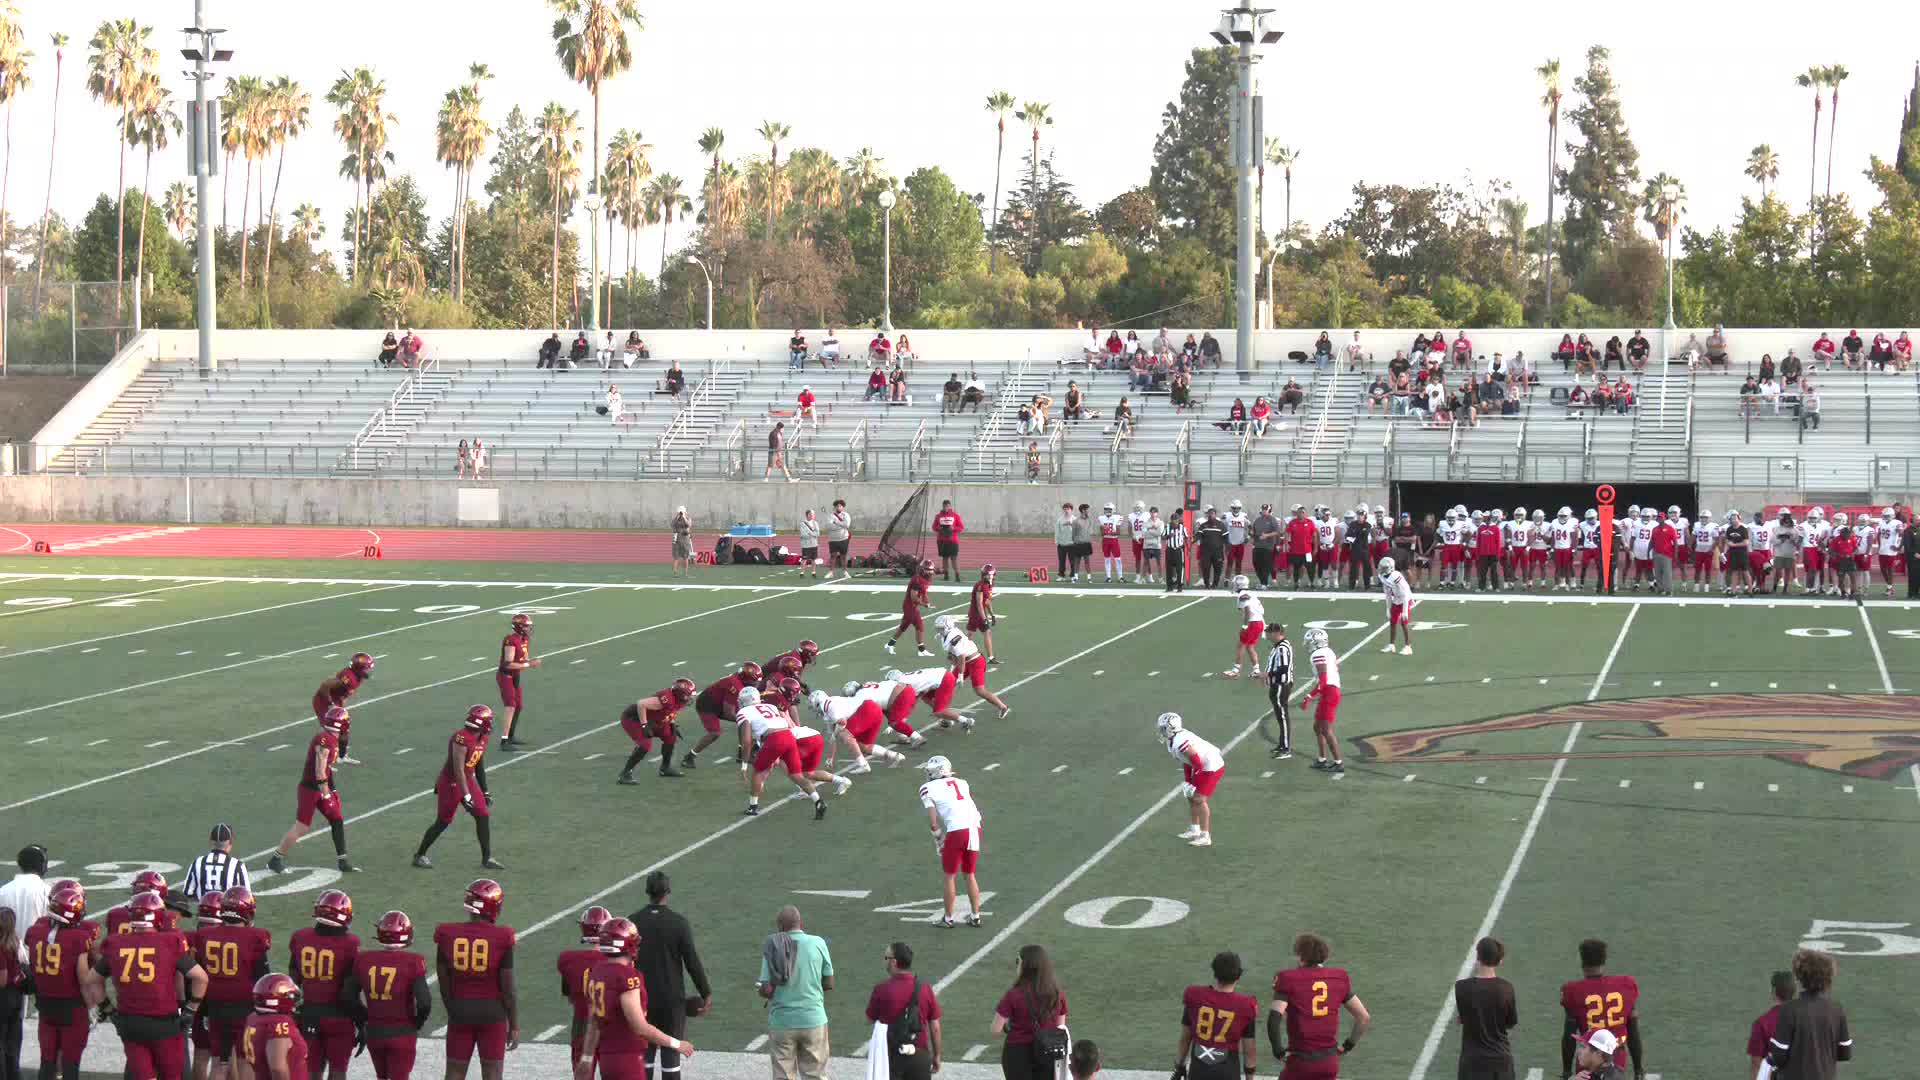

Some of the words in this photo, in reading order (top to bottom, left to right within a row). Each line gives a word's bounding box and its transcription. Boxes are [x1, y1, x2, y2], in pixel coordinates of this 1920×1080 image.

[1514, 531, 1524, 541] 43
[1757, 531, 1768, 542] 39
[364, 546, 376, 558] 10
[697, 551, 710, 564] 20
[1032, 567, 1048, 581] 30
[946, 780, 965, 800] 7
[205, 864, 224, 890] H
[35, 940, 61, 976] 19
[119, 947, 155, 983] 75
[205, 940, 239, 976] 50
[301, 946, 335, 981] 80
[453, 937, 489, 972] 88
[368, 965, 397, 1000] 17
[627, 976, 641, 989] 93
[1312, 980, 1329, 1017] 2
[1585, 991, 1626, 1029] 22
[275, 1022, 289, 1035] 45
[1196, 1006, 1236, 1043] 87
